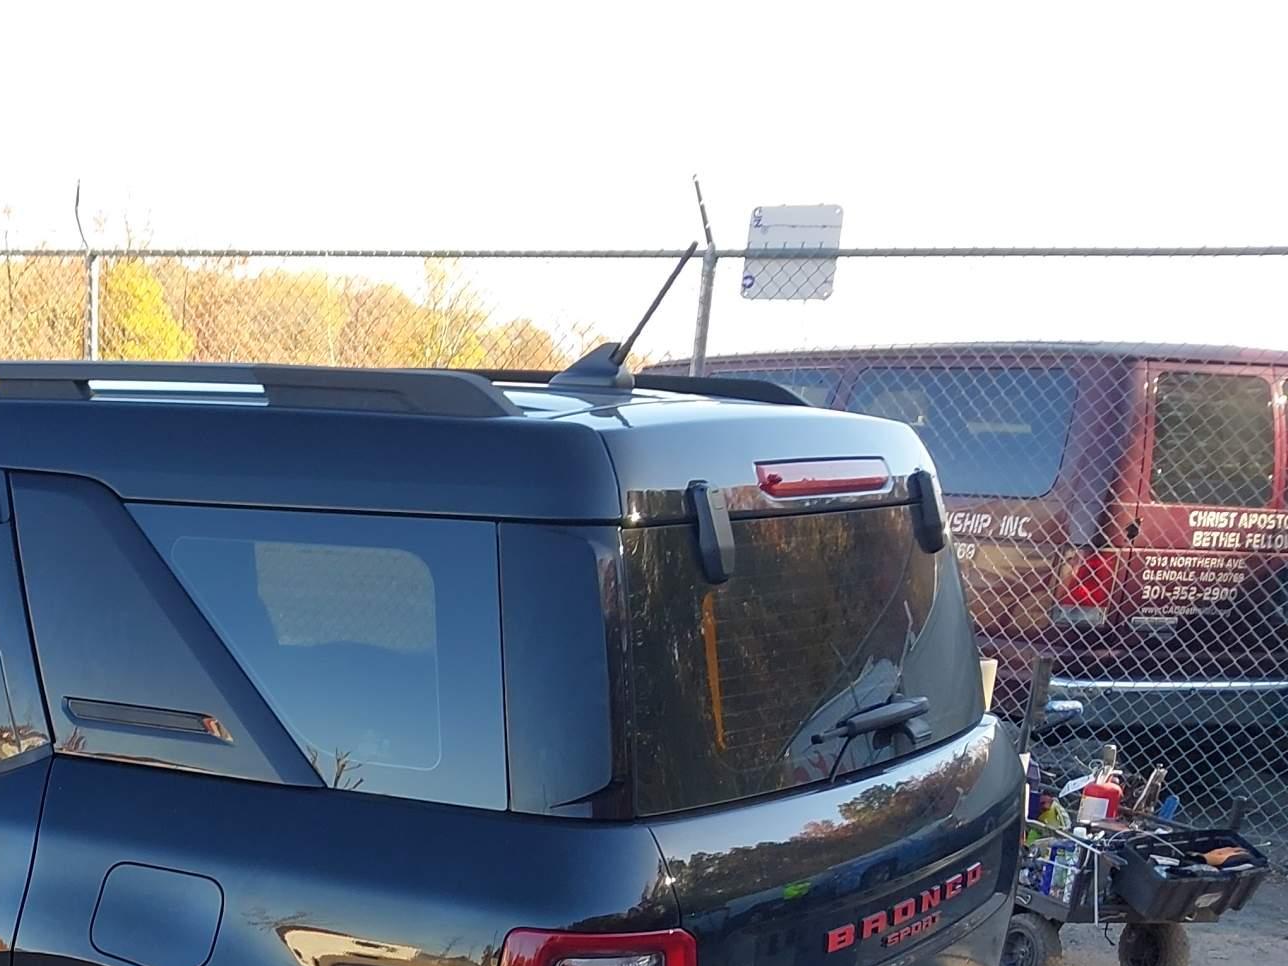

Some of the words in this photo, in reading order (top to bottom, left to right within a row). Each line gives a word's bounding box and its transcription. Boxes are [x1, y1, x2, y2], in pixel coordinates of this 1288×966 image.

[1189, 510, 1238, 528] CHRIST
[1192, 531, 1242, 548] BETHEL
[1145, 556, 1168, 568] 7513
[1169, 556, 1224, 569] NORTHERN
[1199, 571, 1215, 583] MD
[1141, 585, 1238, 601] 301-352-2900
[827, 861, 984, 953] BRONCO
[882, 910, 942, 948] SPORT
